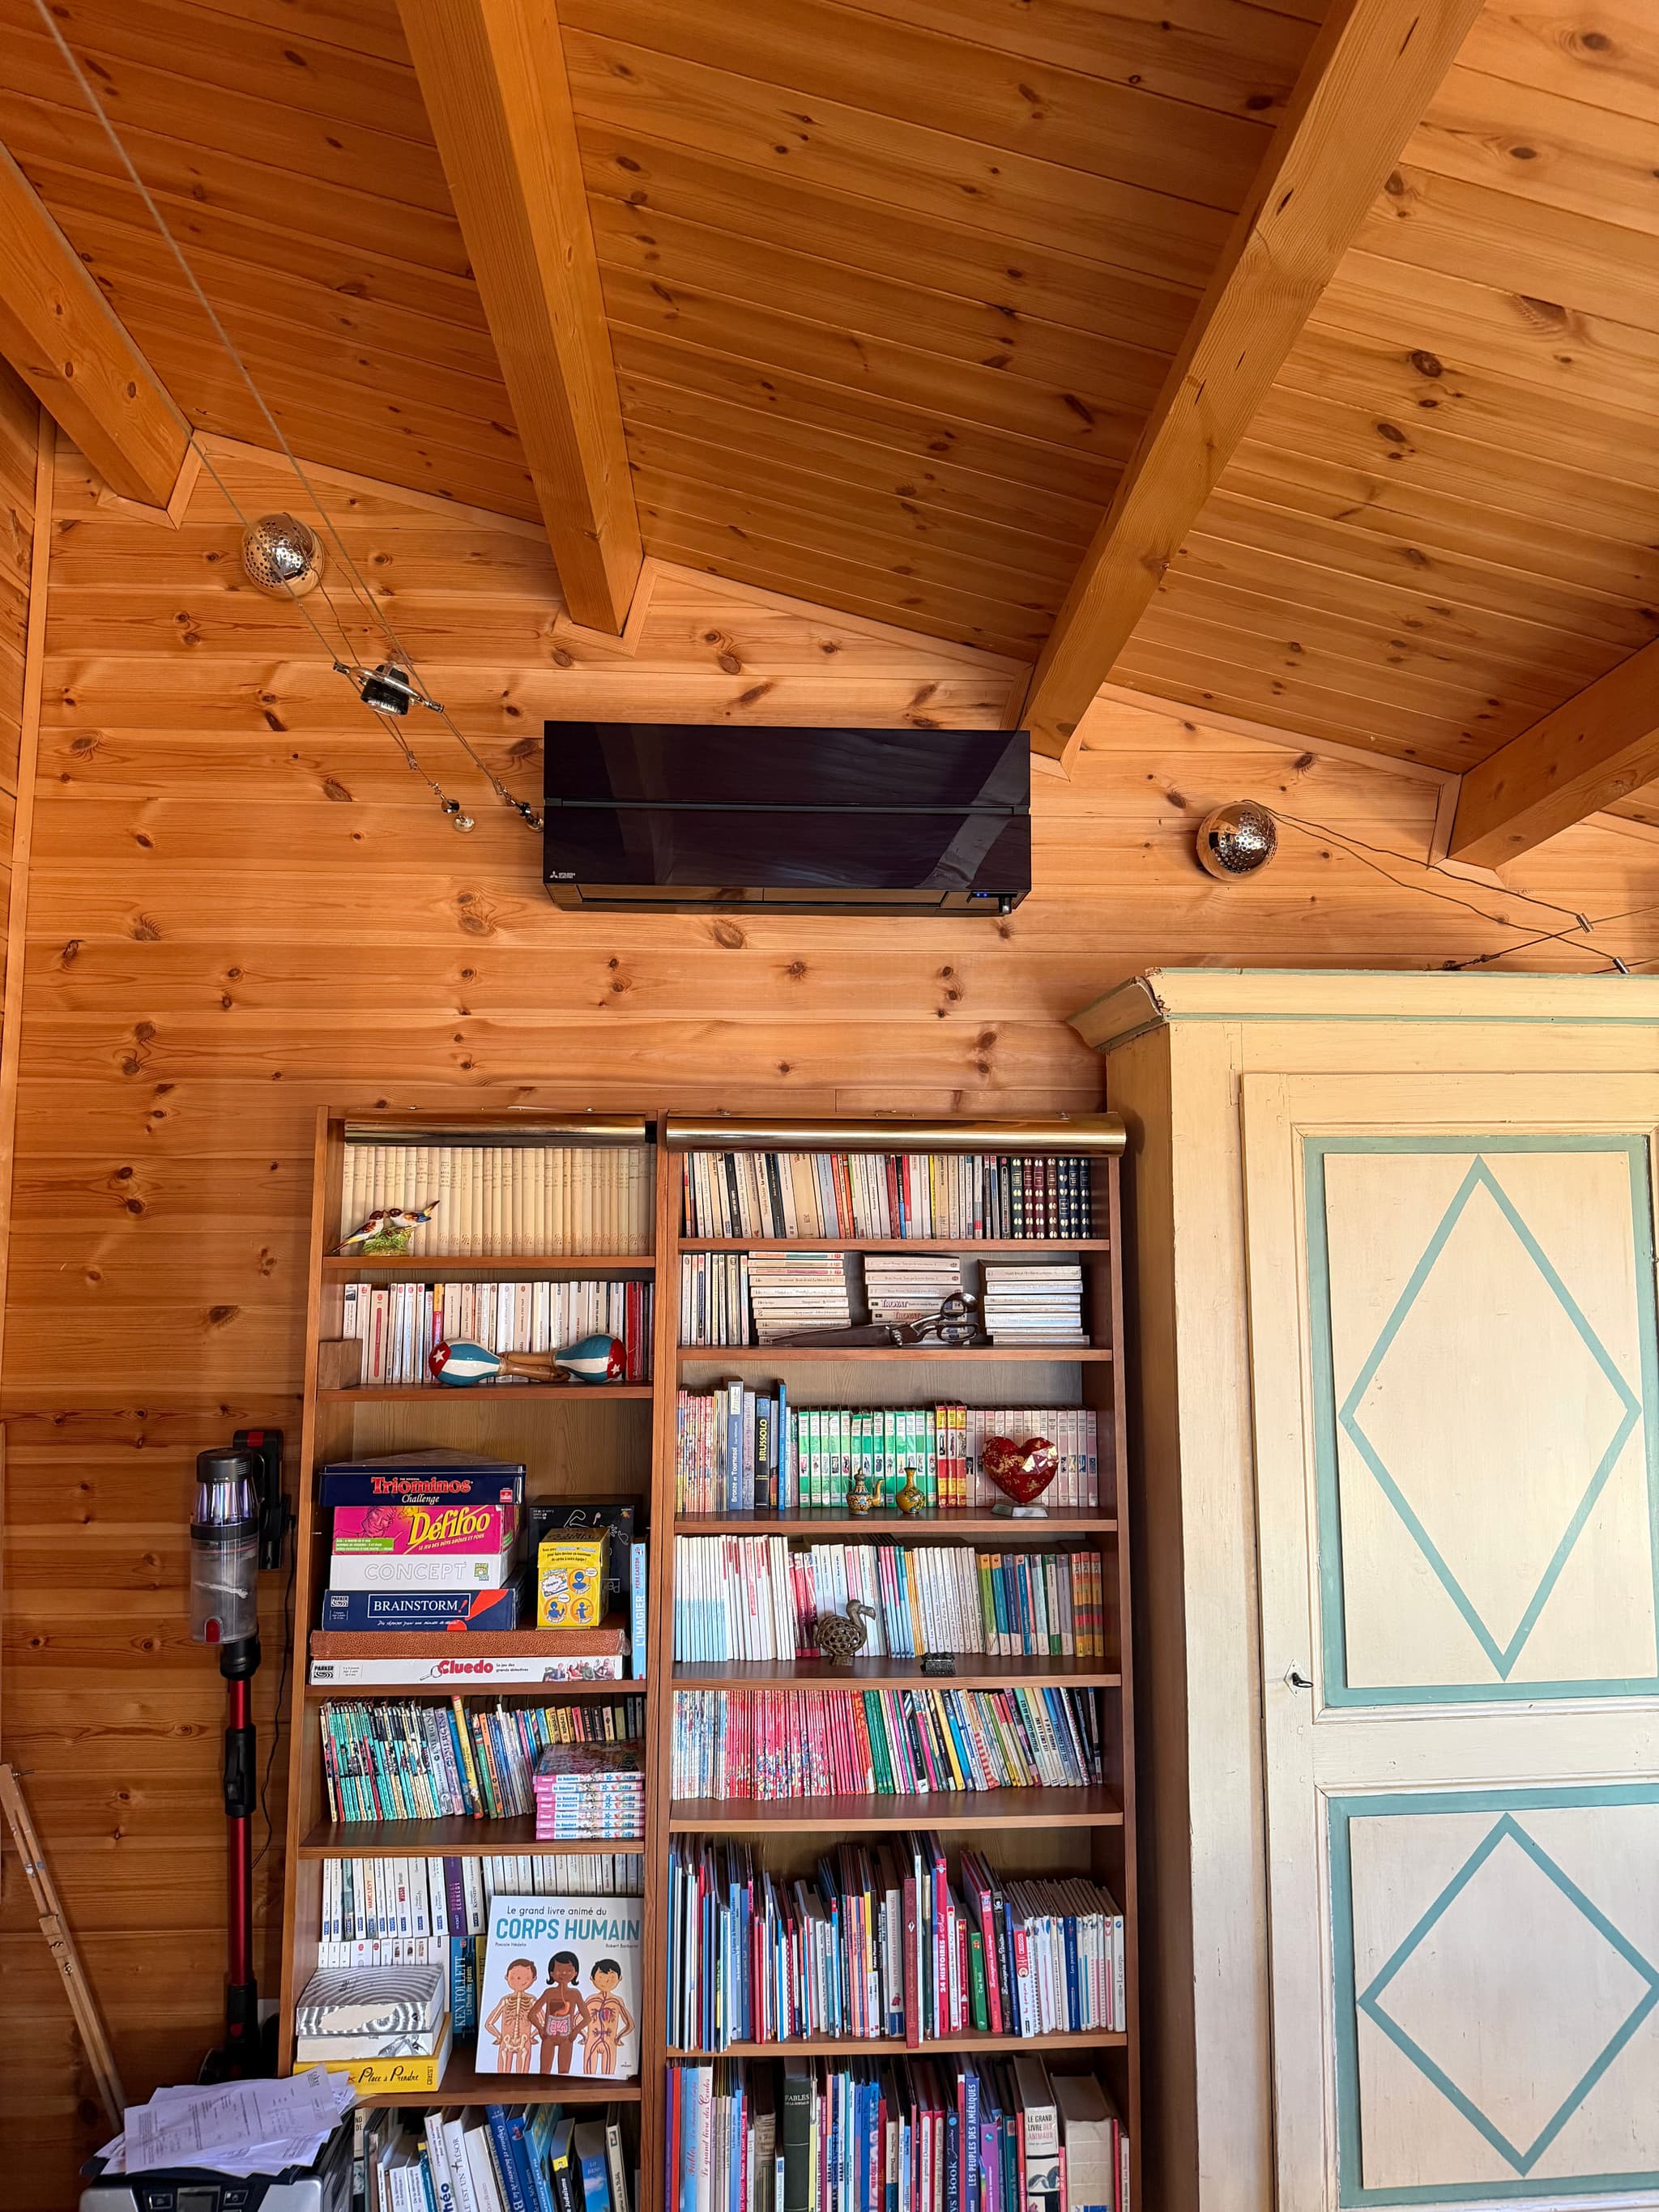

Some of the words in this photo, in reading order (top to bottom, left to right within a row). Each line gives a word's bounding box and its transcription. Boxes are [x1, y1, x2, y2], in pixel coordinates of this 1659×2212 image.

[371, 1477, 472, 1494] Triominos
[401, 1493, 440, 1504] Challenge
[365, 1563, 466, 1581] CONCEPT
[636, 1596, 645, 1646] L'IMAGIER
[438, 1660, 493, 1676] Cluedo
[425, 1711, 439, 1754] EMERGING
[438, 1712, 451, 1760] EMERGING
[507, 1907, 517, 1915] Le
[519, 1906, 544, 1916] grand
[548, 1907, 565, 1915] livre
[568, 1907, 594, 1916] animé
[596, 1907, 608, 1916] du
[496, 1918, 560, 1940] CORPS
[565, 1919, 640, 1941] HUMAIN
[455, 1955, 466, 2002] FOLLETT
[1116, 1973, 1123, 1983] Le
[940, 1983, 946, 1993] 24
[454, 2005, 466, 2027] KEN
[390, 2065, 420, 2082] Prendre
[698, 2078, 710, 2105] Contes
[785, 2094, 809, 2102] FABLES
[702, 2106, 710, 2119] des
[966, 2085, 977, 2124] AMÉRIQUES
[1034, 2114, 1052, 2122] GRAND
[702, 2120, 710, 2138] livre
[1027, 2124, 1042, 2132] LIVRE
[1043, 2122, 1052, 2130] DES
[702, 2140, 710, 2165] grand
[686, 2146, 695, 2177] Fables
[458, 2172, 467, 2185] UN
[702, 2167, 709, 2177] Le
[948, 2161, 957, 2195] Book
[462, 2189, 470, 2201] EST
[512, 2190, 518, 2198] la
[561, 2177, 572, 2208] Judaïsme
